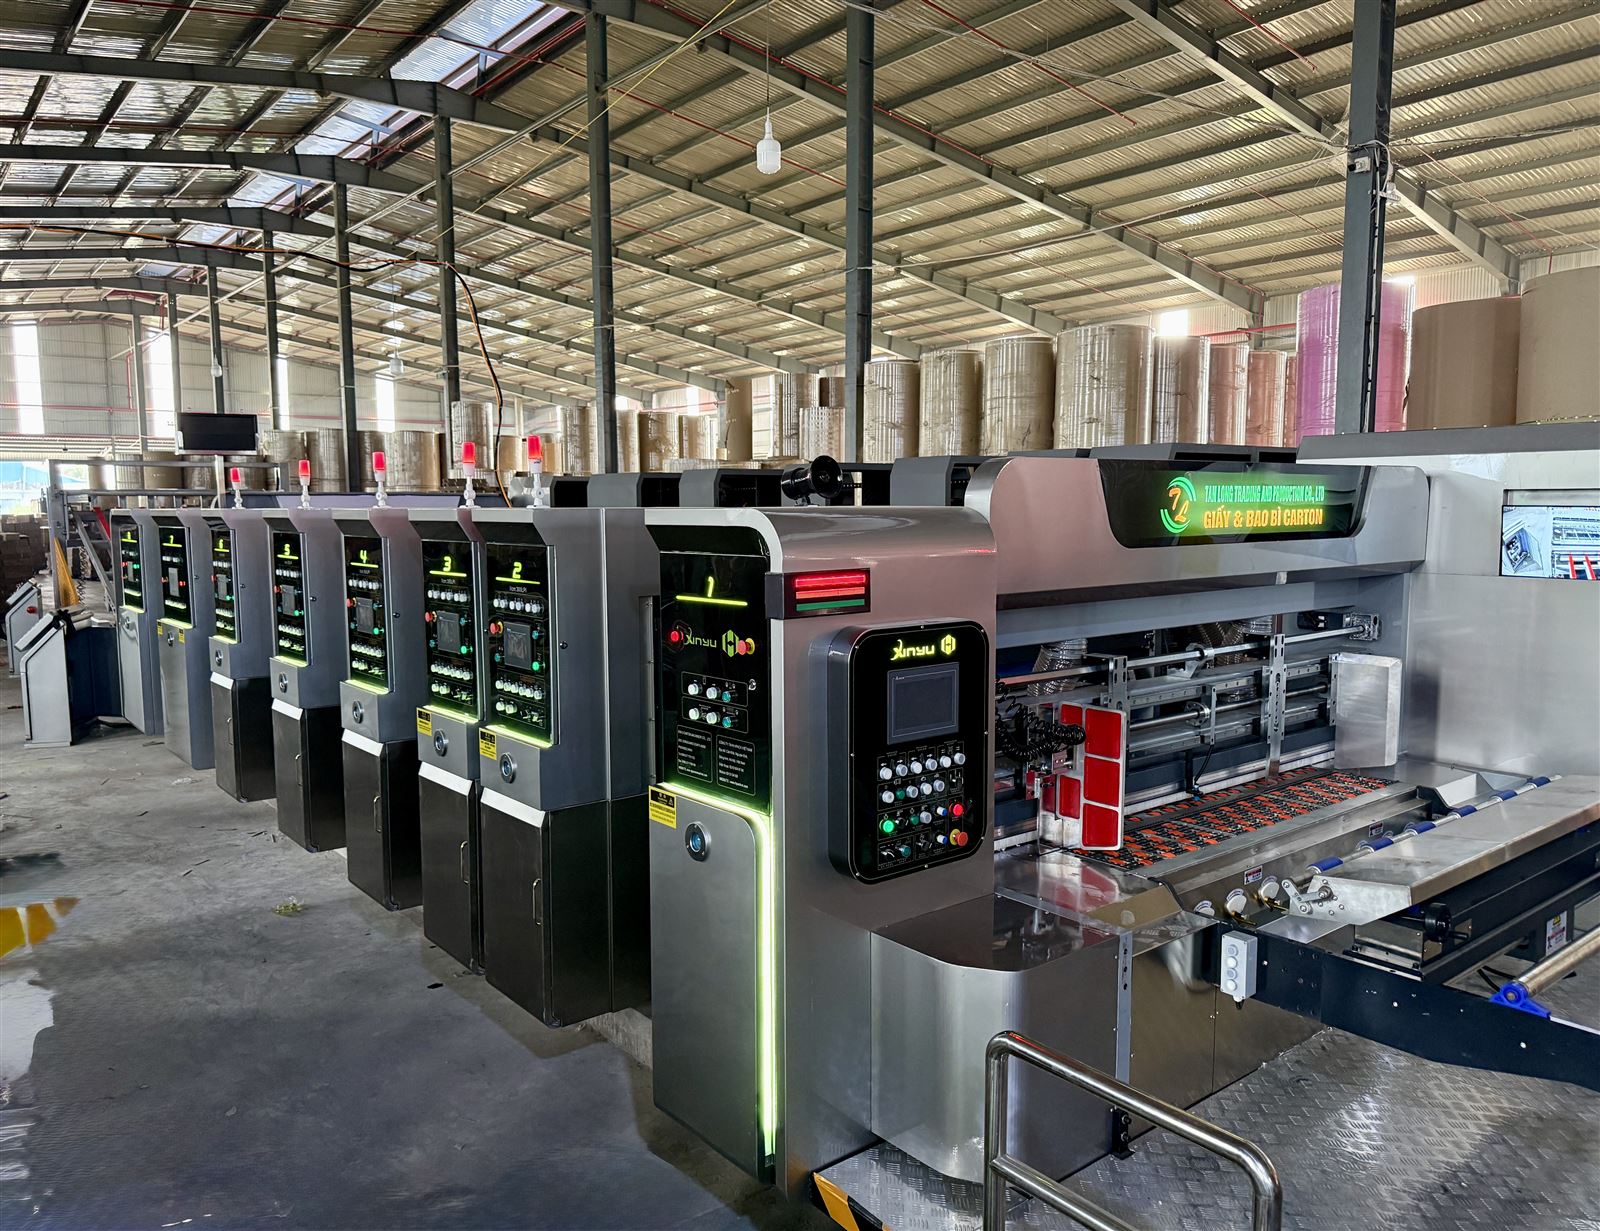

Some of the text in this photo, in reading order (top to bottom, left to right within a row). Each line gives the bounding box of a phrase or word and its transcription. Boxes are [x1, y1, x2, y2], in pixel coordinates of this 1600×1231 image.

[1217, 485, 1234, 503] LONG
[1234, 485, 1261, 503] TRADING
[1261, 485, 1273, 502] AND
[1273, 485, 1304, 502] PRODUCTION
[1315, 485, 1325, 502] LTD
[1203, 505, 1324, 529] GIẤY & BAO BÌ CARTON
[283, 543, 291, 556] 5
[359, 549, 368, 564] 4
[442, 555, 452, 572] 3
[512, 561, 523, 579] 2
[706, 575, 715, 598] 1
